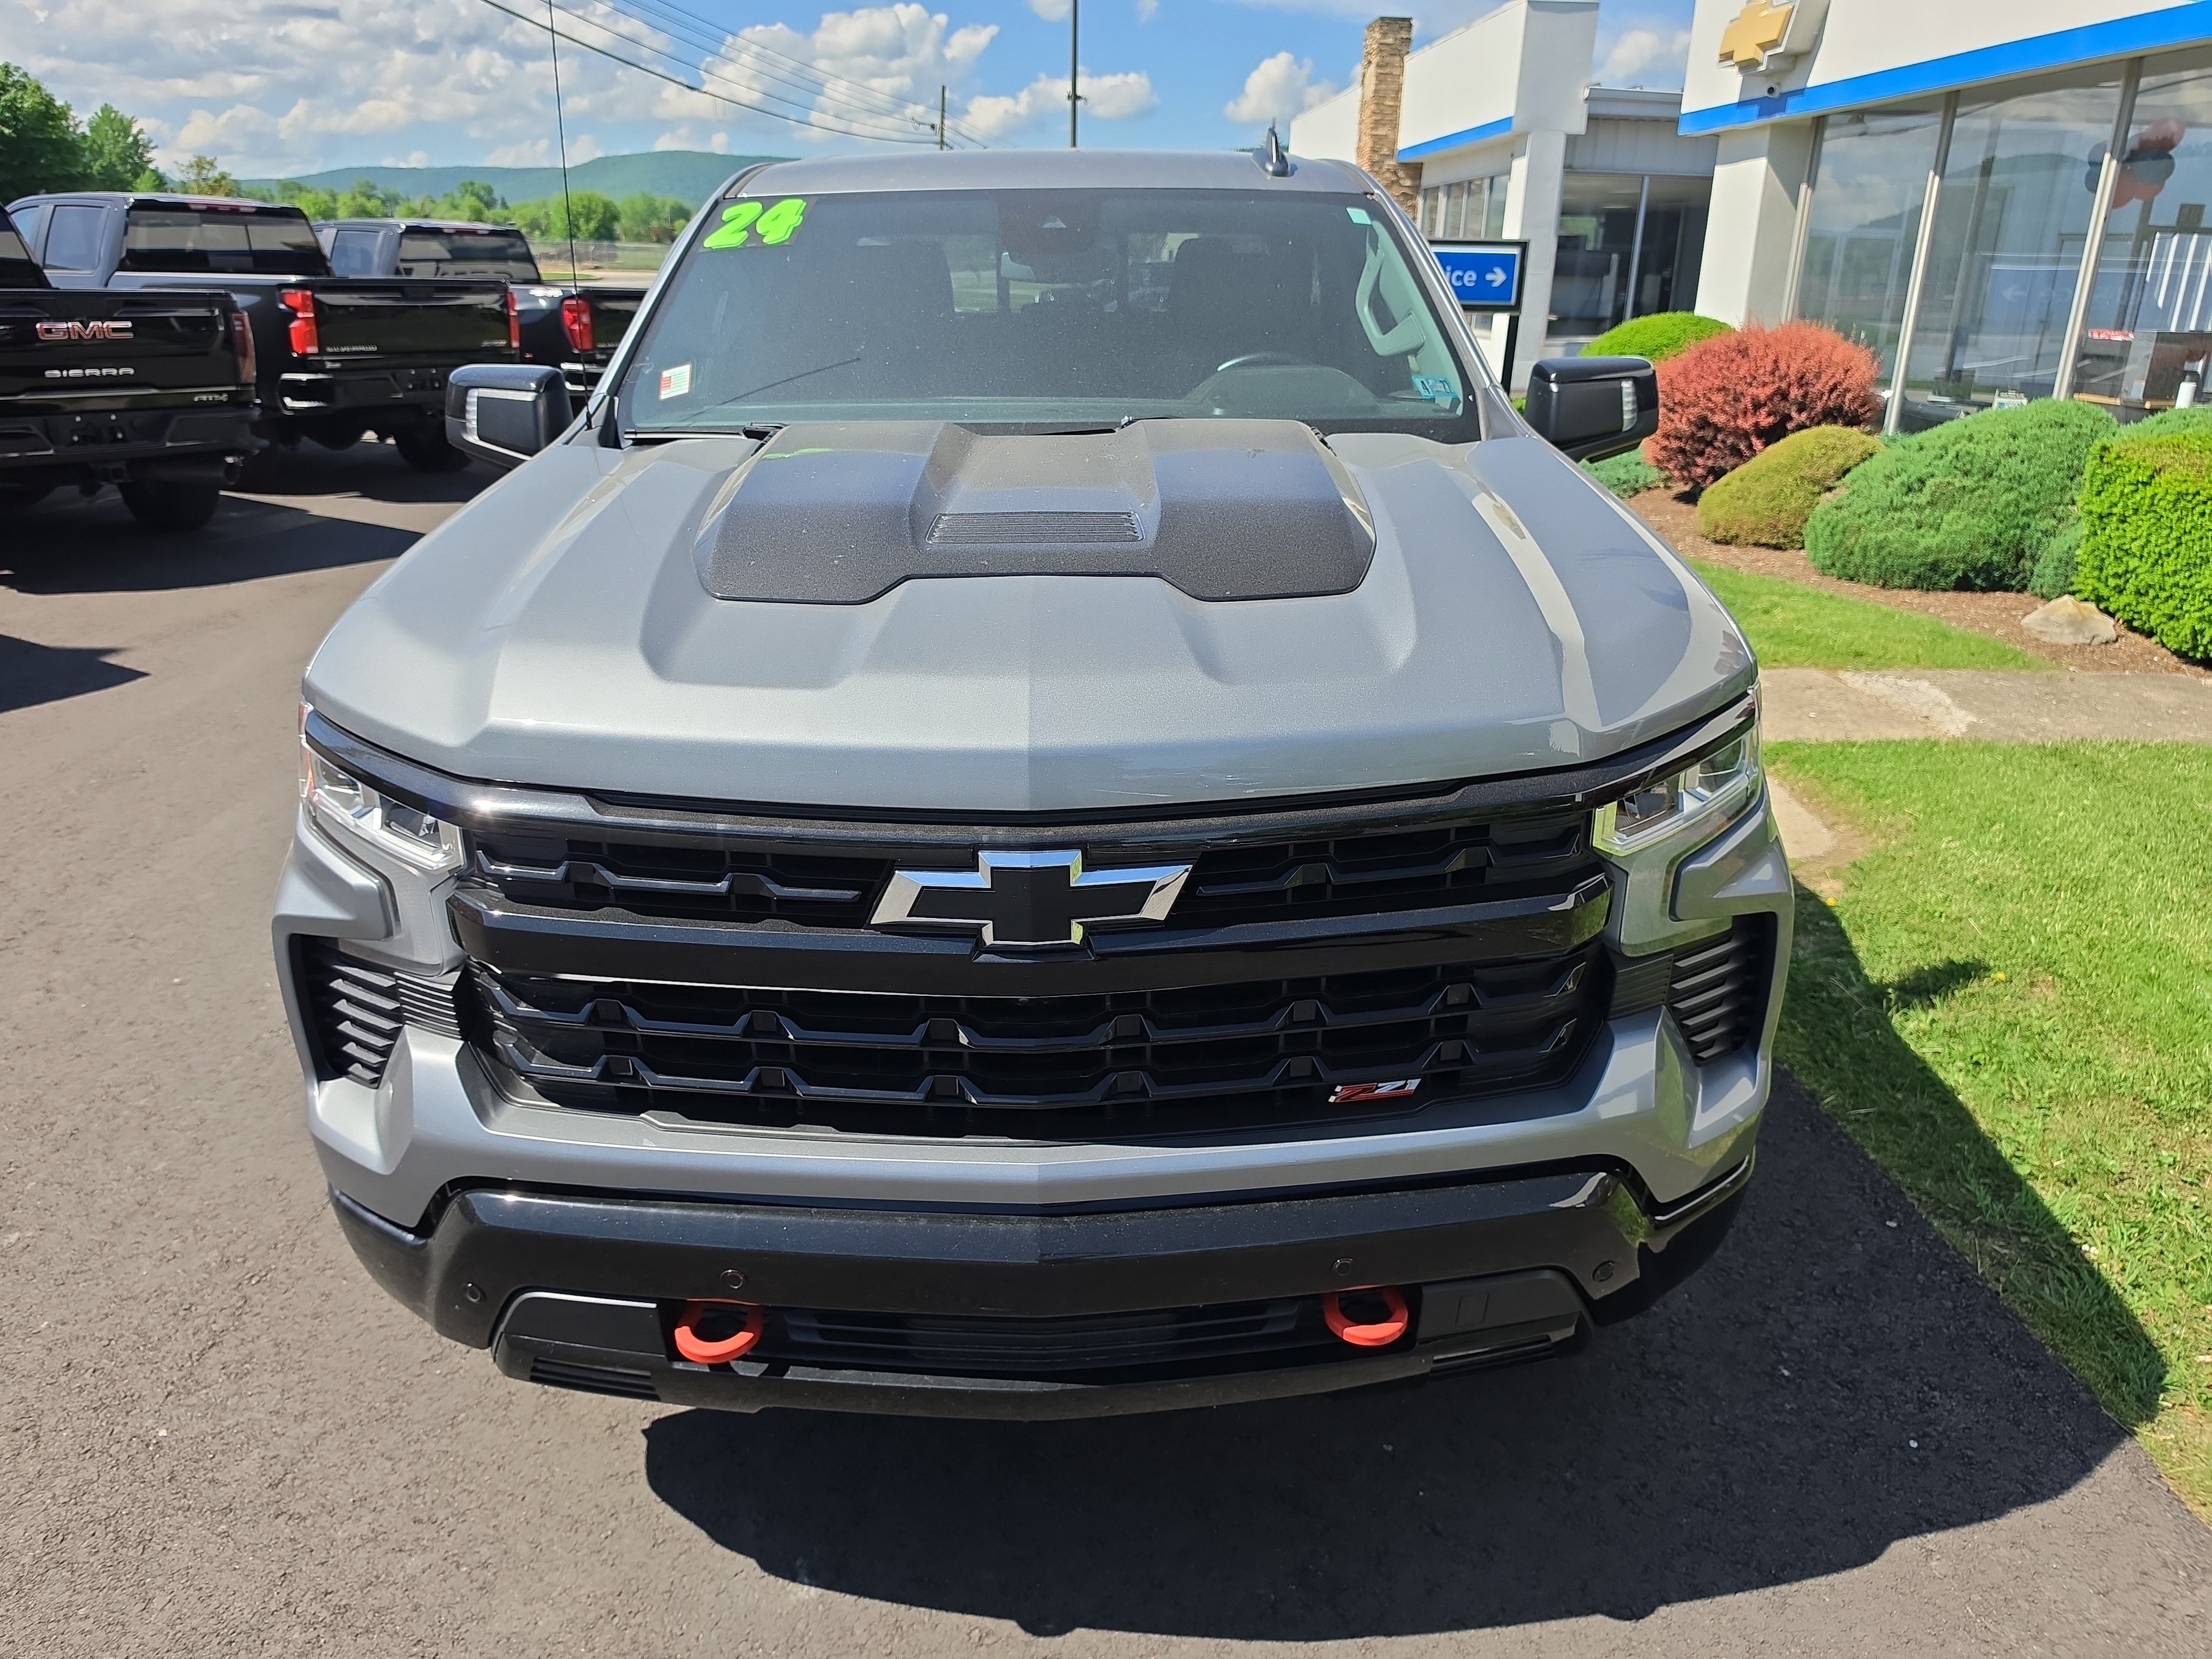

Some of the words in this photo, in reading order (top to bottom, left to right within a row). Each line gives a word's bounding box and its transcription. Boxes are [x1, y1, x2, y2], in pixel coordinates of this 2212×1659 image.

[703, 199, 807, 249] 24
[1445, 265, 1477, 286] ice
[36, 321, 134, 340] GMC
[44, 367, 134, 378] SIERRA
[1328, 1078, 1422, 1103] Z71
